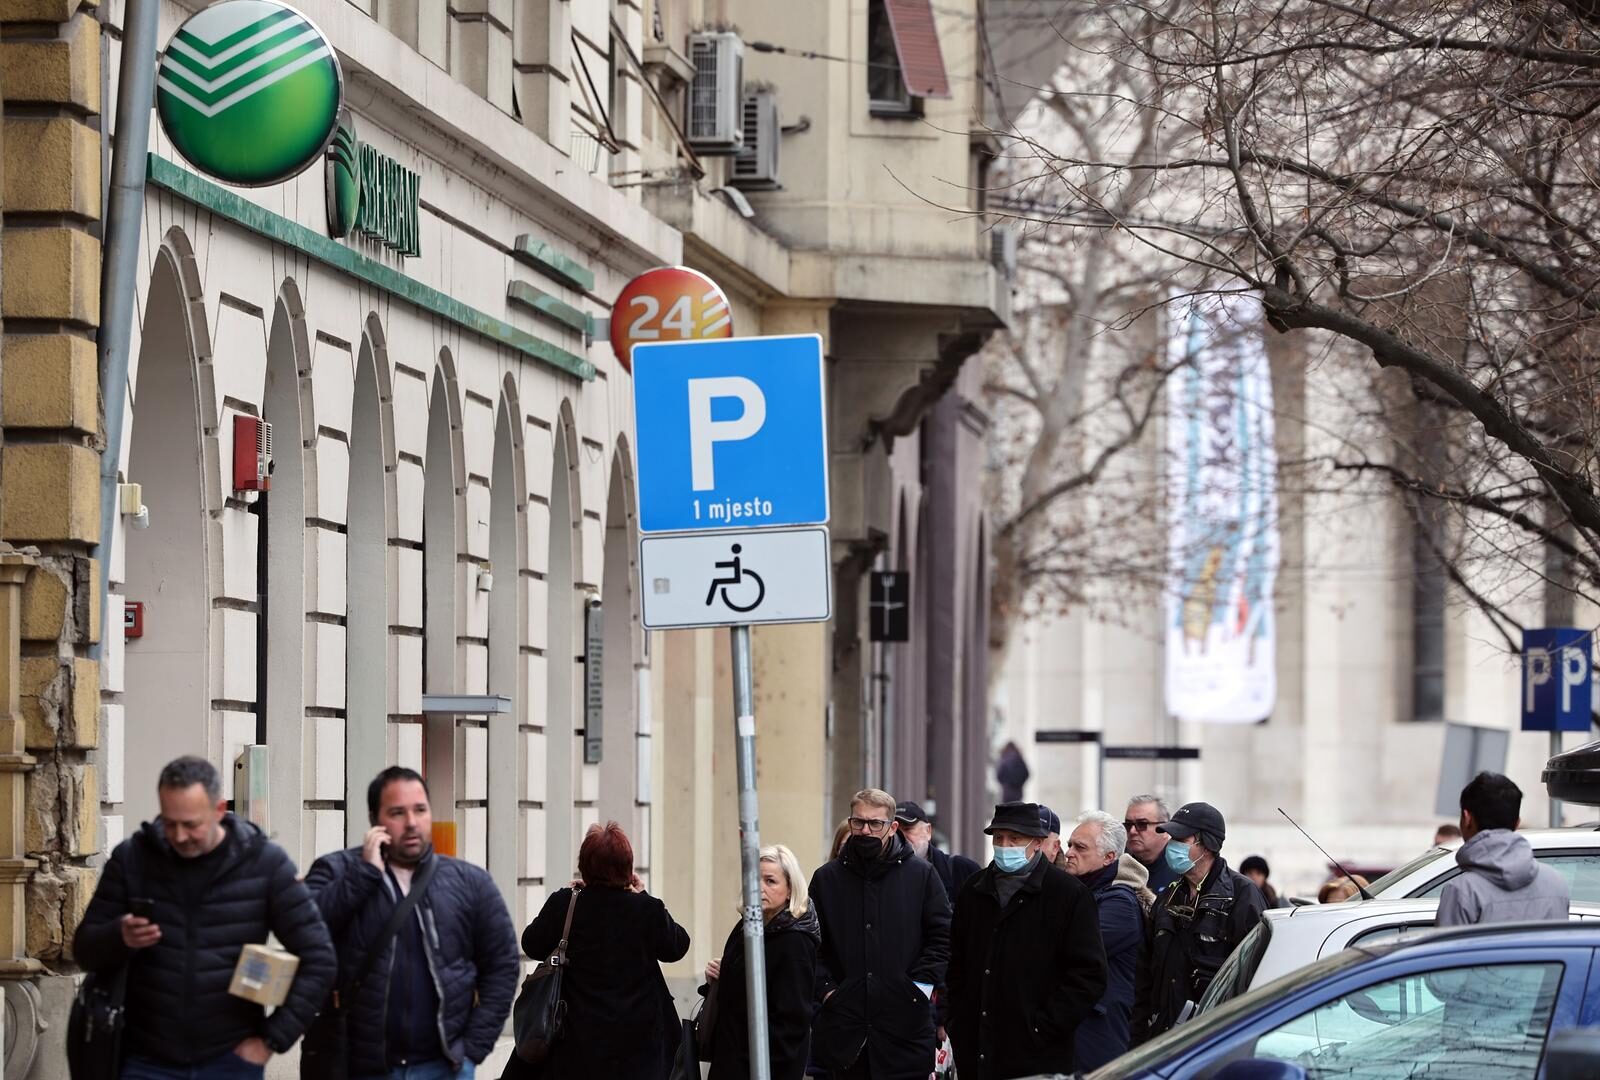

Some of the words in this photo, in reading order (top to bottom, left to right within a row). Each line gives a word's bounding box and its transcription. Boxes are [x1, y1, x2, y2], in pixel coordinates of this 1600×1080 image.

[629, 295, 696, 339] 24
[688, 376, 767, 491] P
[694, 499, 700, 520] 1
[709, 497, 772, 523] mjesto
[1527, 647, 1551, 713] P
[1562, 646, 1587, 713] P
